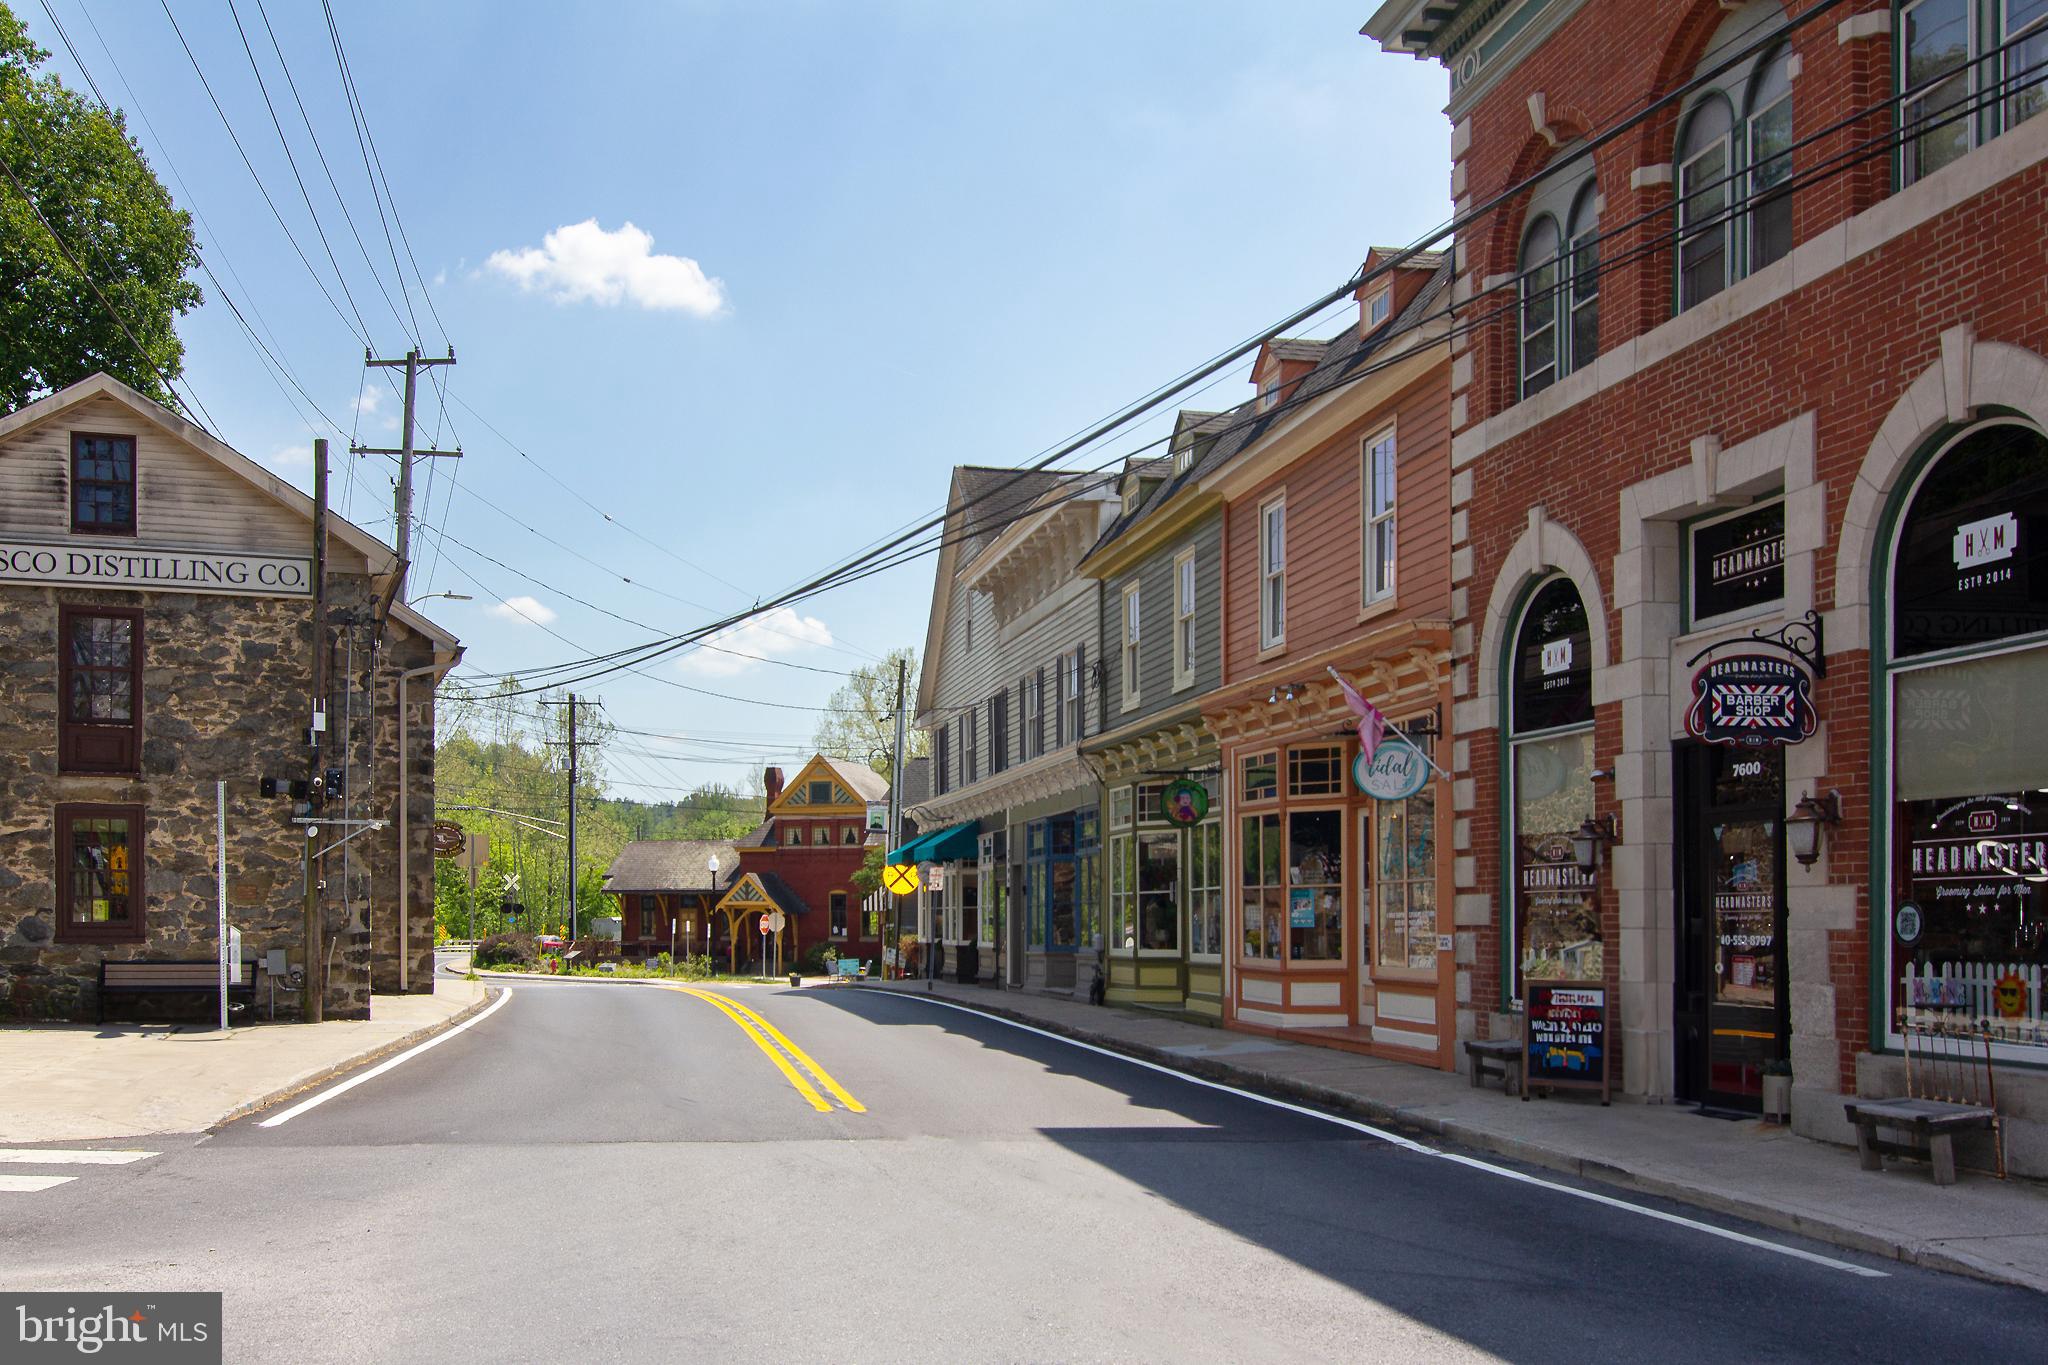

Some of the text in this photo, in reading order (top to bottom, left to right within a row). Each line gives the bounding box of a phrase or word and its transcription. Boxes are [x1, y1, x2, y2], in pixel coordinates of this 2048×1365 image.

[66, 552, 249, 584] DISTILLING
[258, 563, 305, 587] CO.
[1986, 567, 2012, 585] 2014
[1710, 661, 1795, 678] HEADMASTERS
[1726, 694, 1780, 706] BARBER
[1735, 705, 1772, 716] SHOP
[1732, 761, 1761, 777] 7600
[1912, 841, 2046, 872] HEADMASTER
[1936, 883, 2032, 900] Grooming Salon for Men
